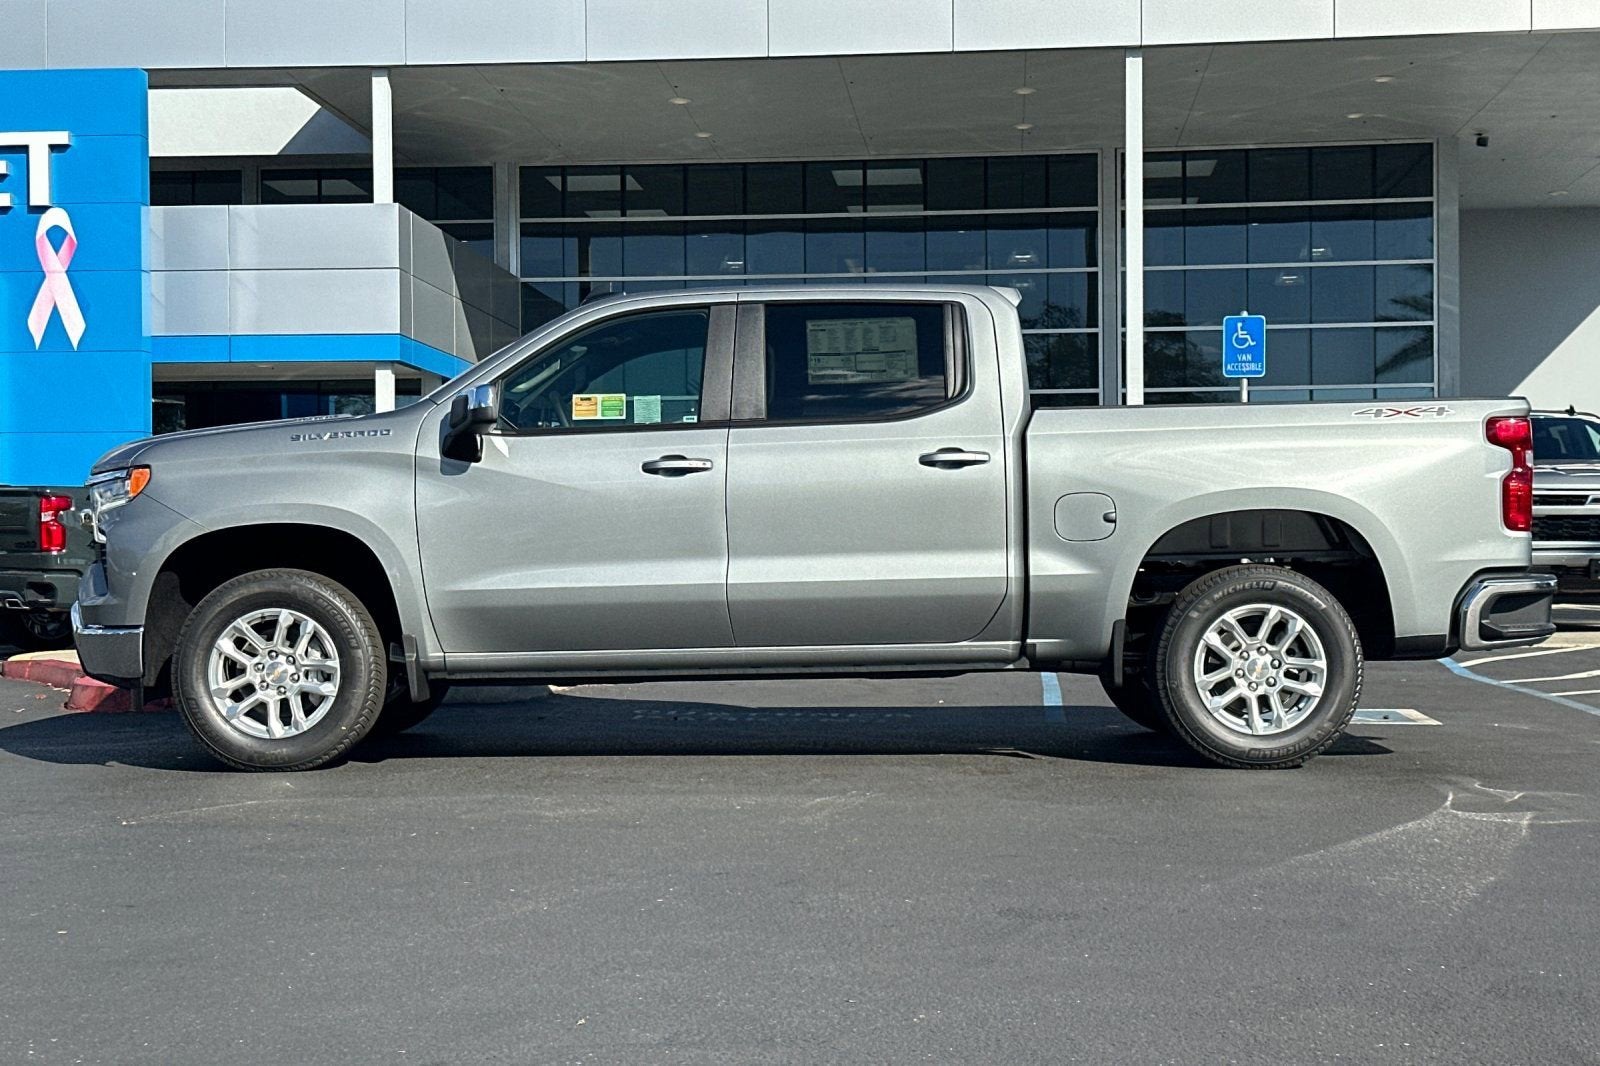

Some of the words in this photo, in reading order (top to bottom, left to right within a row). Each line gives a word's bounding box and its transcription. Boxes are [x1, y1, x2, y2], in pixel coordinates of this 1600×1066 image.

[0, 130, 70, 207] T
[1237, 353, 1252, 362] VAN
[1226, 362, 1263, 372] ACCESSIBLE
[290, 428, 393, 442] SILVERADO
[1213, 581, 1275, 601] MICHELIN
